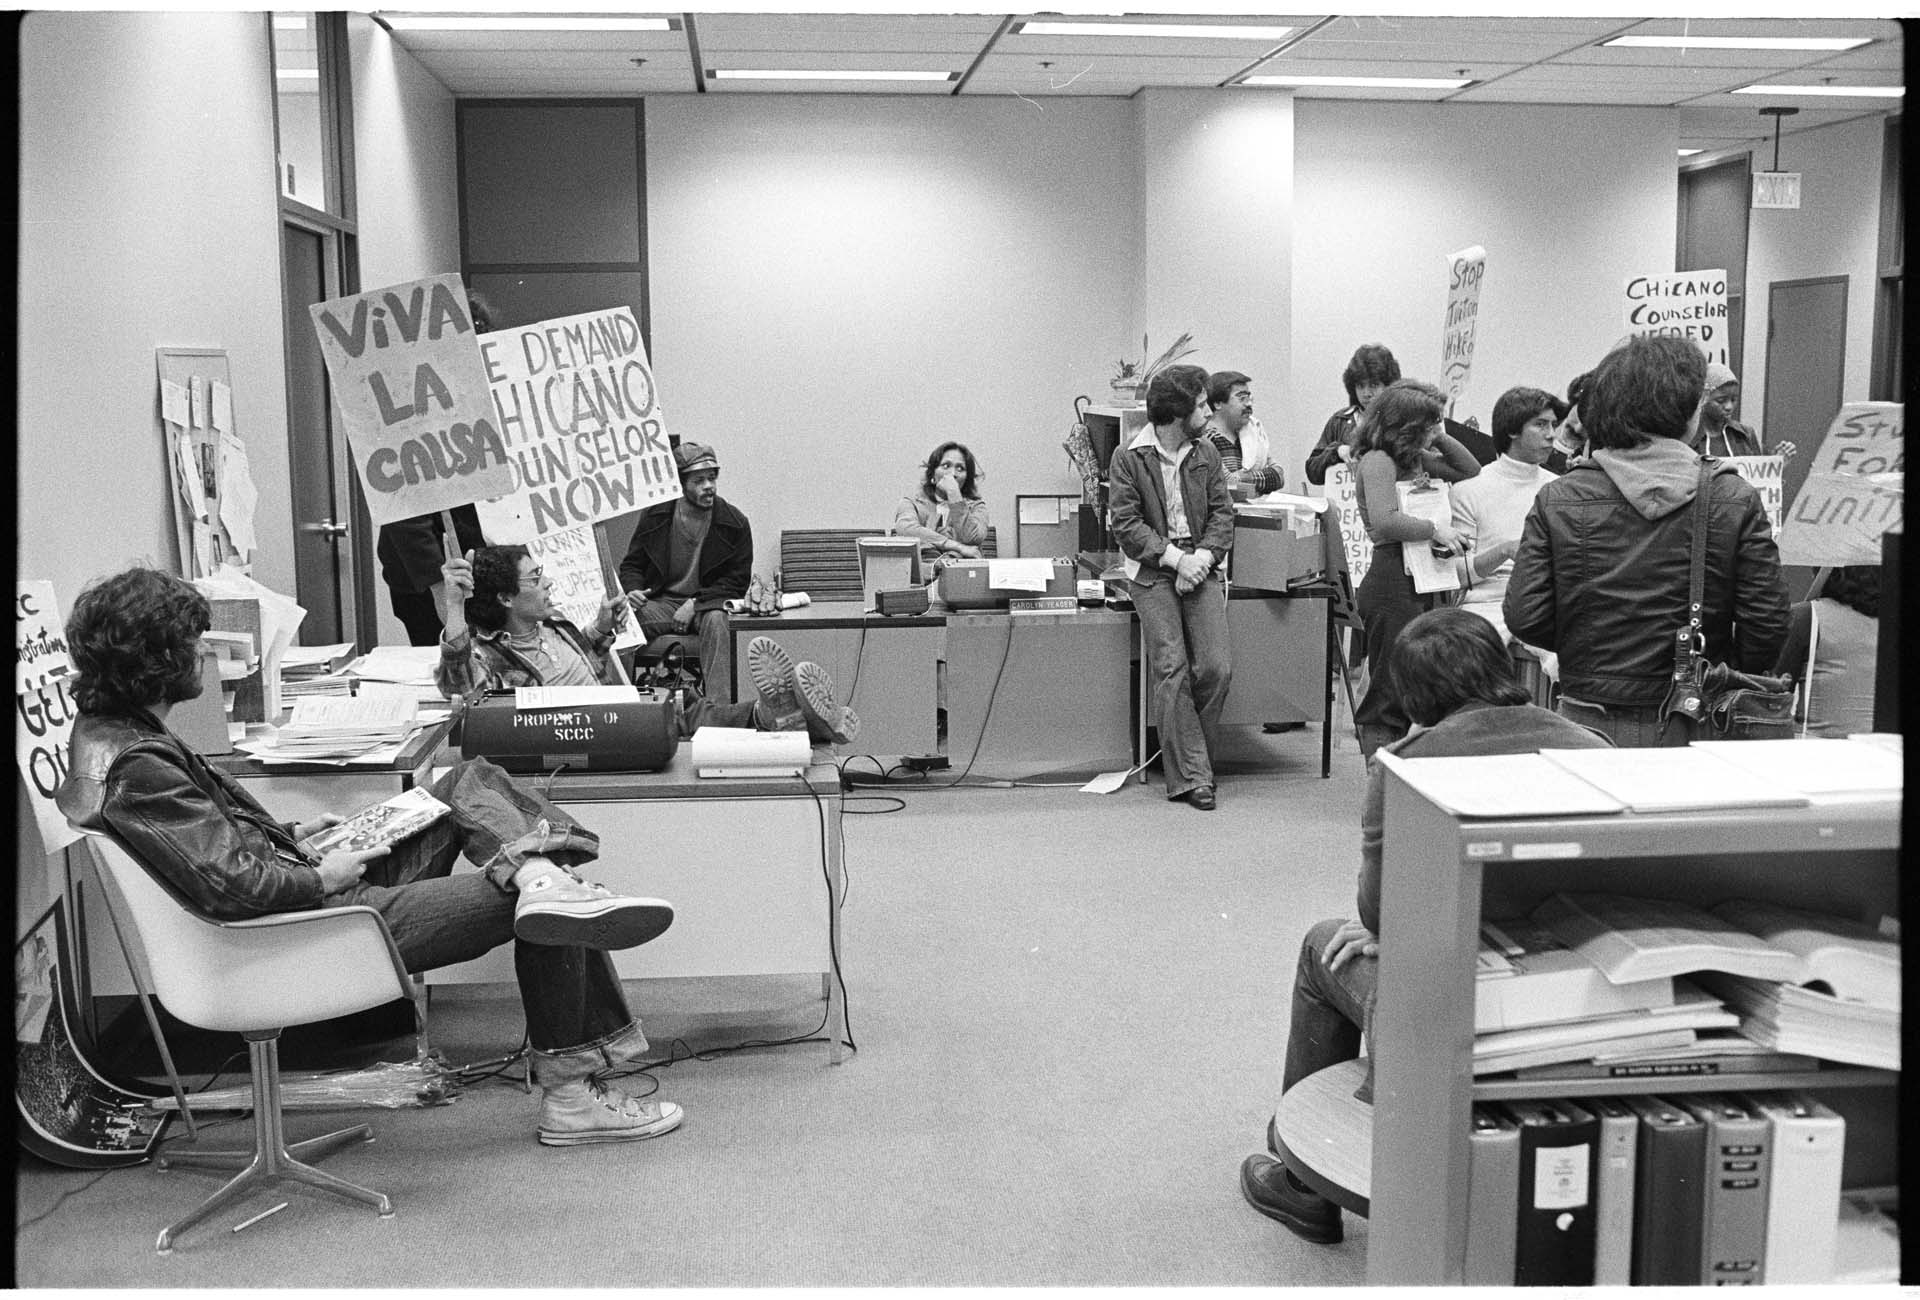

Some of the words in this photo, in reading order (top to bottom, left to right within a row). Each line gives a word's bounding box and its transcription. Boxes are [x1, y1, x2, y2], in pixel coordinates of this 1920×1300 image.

[480, 341, 509, 384] E
[521, 312, 640, 377] DEMAND
[368, 363, 454, 426] LA
[492, 360, 655, 447] HICANO
[366, 418, 508, 494] CAUSA
[506, 419, 668, 495] OUNSELOR
[1335, 470, 1357, 485] STU
[1737, 461, 1783, 479] OWN
[514, 712, 591, 727] PROPERTY
[554, 728, 594, 741] SCCC
